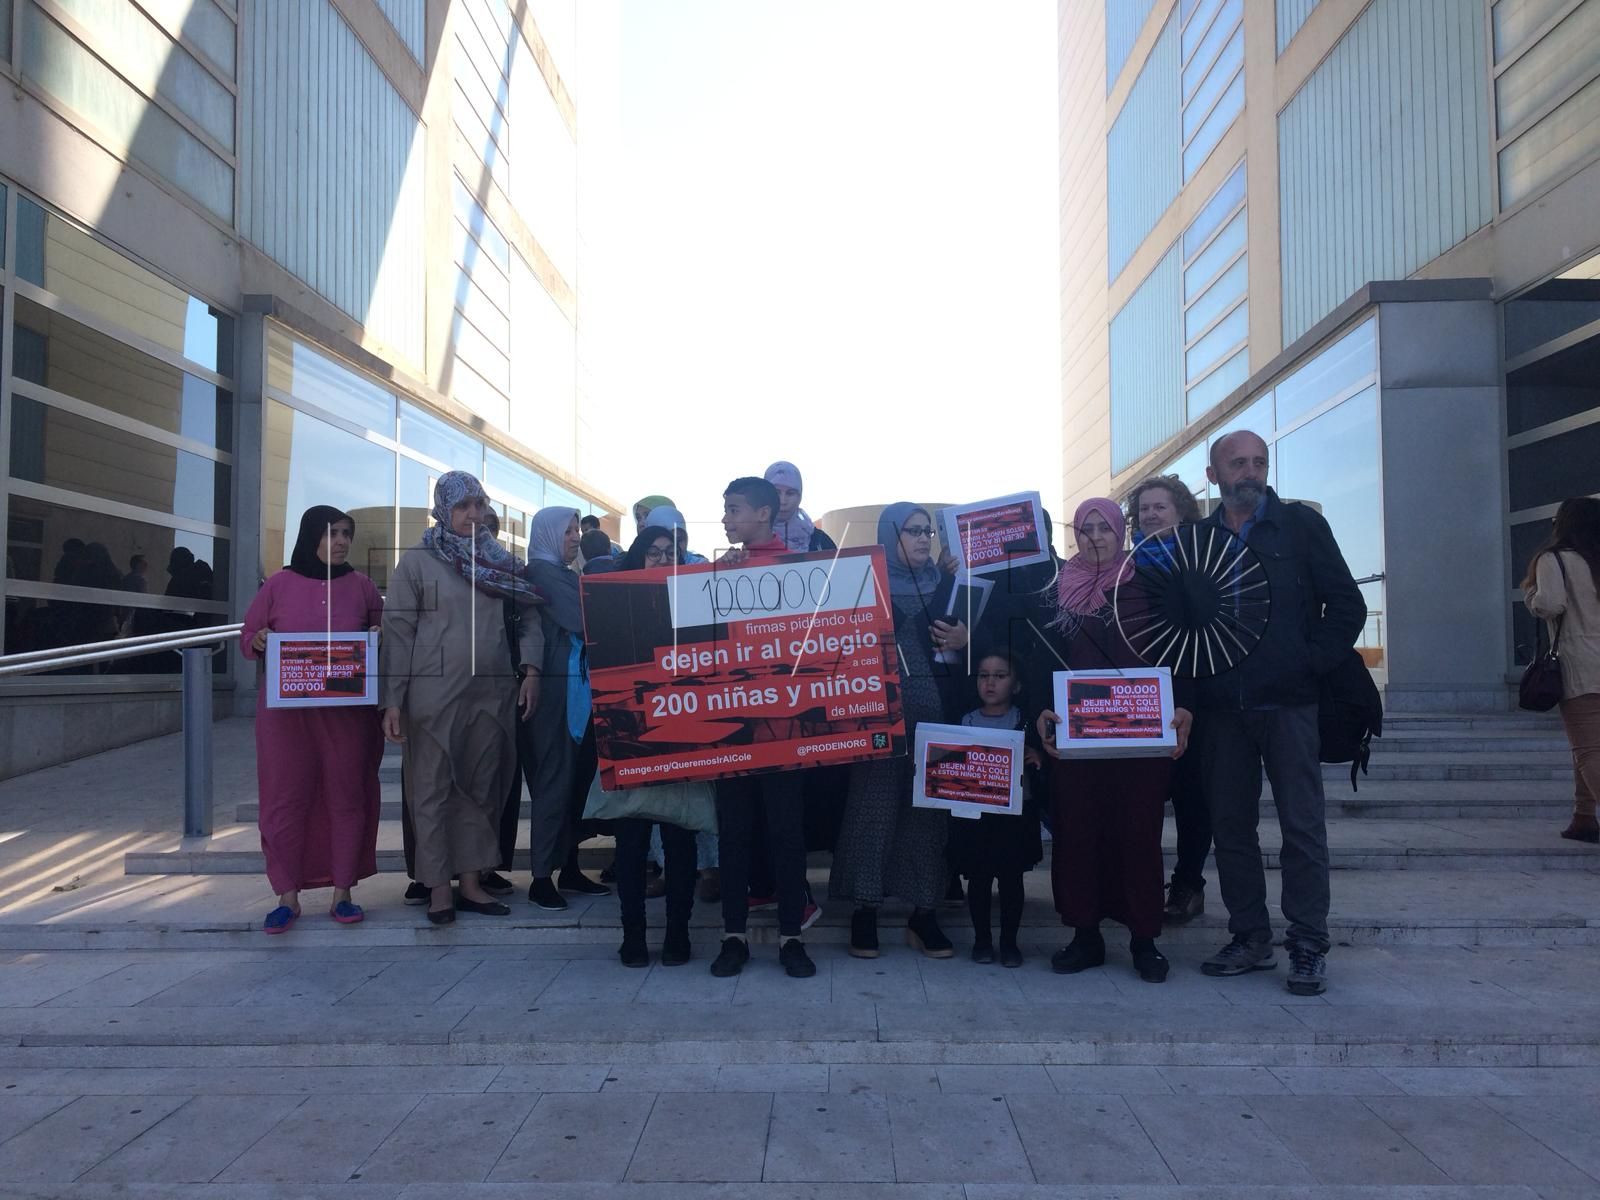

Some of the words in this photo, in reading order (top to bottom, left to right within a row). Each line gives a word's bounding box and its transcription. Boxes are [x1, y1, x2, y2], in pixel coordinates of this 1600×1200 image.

[1002, 532, 1024, 542] DEJEN
[702, 567, 830, 617] 100000
[746, 622, 786, 635] firmas
[790, 614, 845, 632] pidiendo
[850, 613, 873, 627] que
[662, 647, 728, 673] dejen
[737, 643, 752, 662] ir
[761, 639, 781, 659] al
[790, 630, 878, 656] colegio
[860, 656, 879, 666] casi
[282, 682, 325, 691] 100.000
[1112, 685, 1157, 694] 100.000
[652, 692, 698, 717] 200
[708, 687, 779, 711] niñas
[786, 684, 802, 706] y
[811, 675, 882, 699] niños
[831, 705, 845, 717] de
[849, 701, 884, 715] Melilla
[797, 739, 867, 756] @PRODEINORG
[618, 753, 752, 777] change.org/QueremosIrAlCole
[967, 752, 1009, 764] 100.000
[989, 767, 1009, 775] COLE
[989, 773, 1009, 781] NIÑAS
